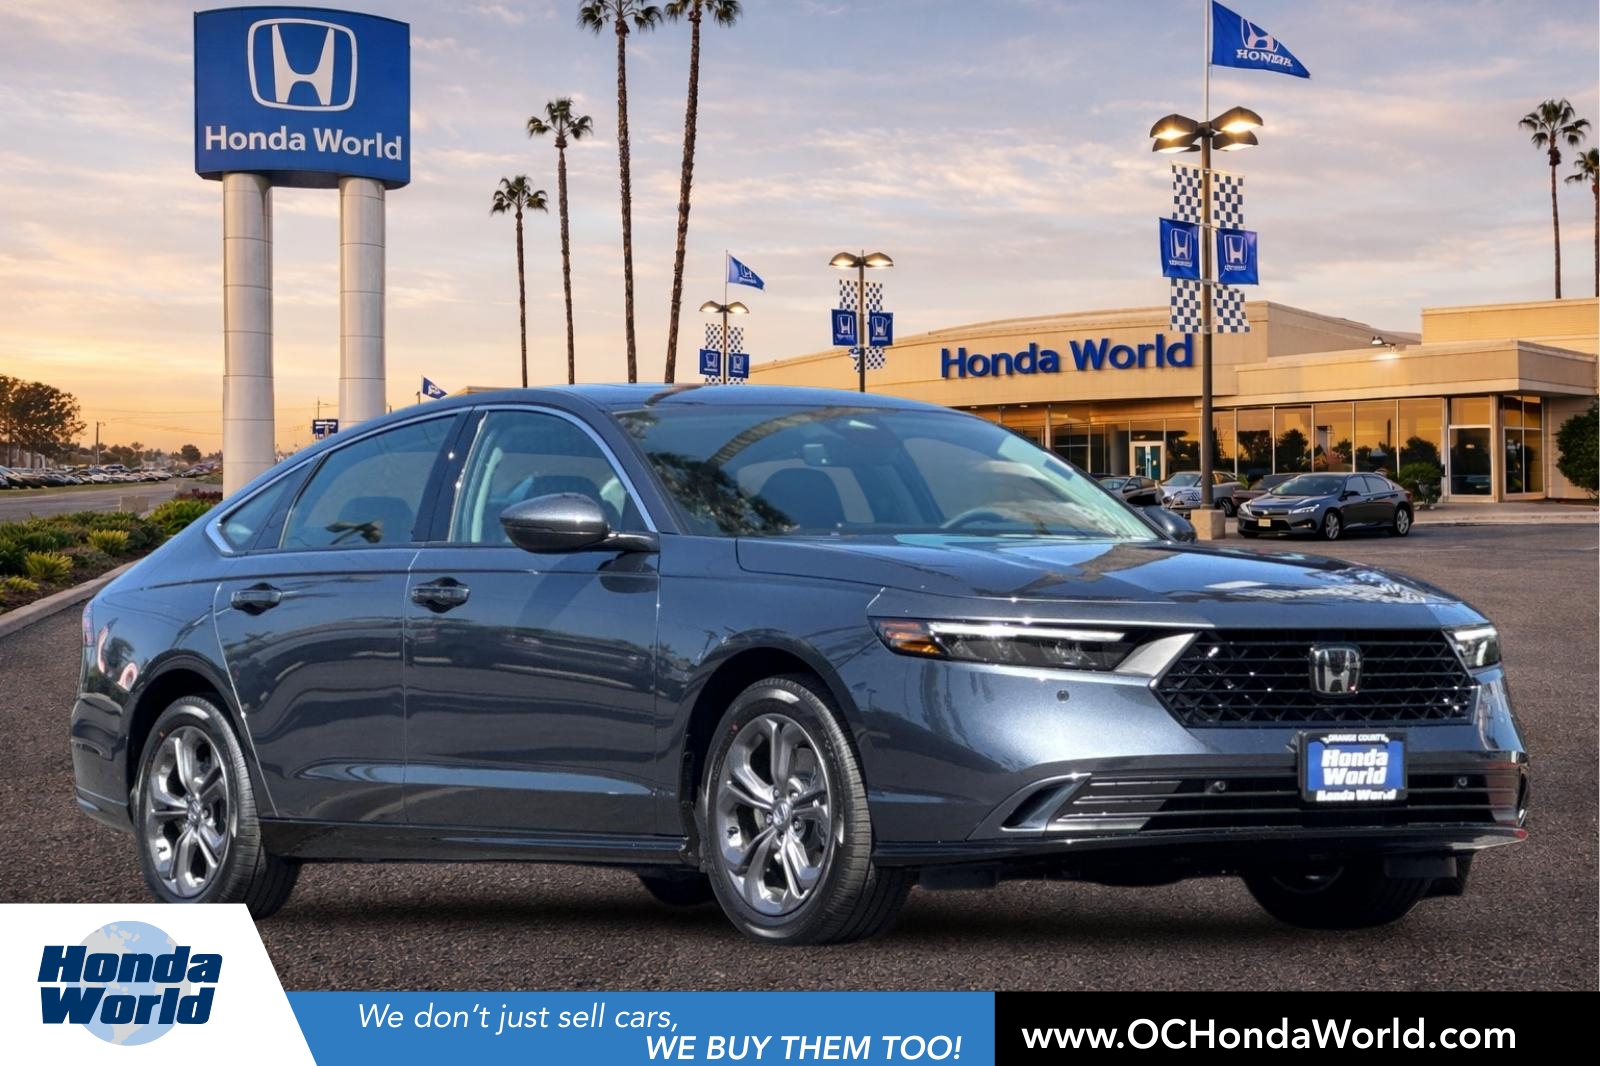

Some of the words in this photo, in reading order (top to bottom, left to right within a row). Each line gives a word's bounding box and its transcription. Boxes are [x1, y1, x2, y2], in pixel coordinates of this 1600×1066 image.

[205, 125, 305, 151] Honda
[313, 127, 402, 160] World
[941, 342, 1060, 378] Honda
[1070, 333, 1194, 371] World
[1321, 748, 1389, 767] Honda
[1323, 767, 1387, 785] World
[1316, 789, 1355, 801] Honda
[1356, 788, 1397, 801] World
